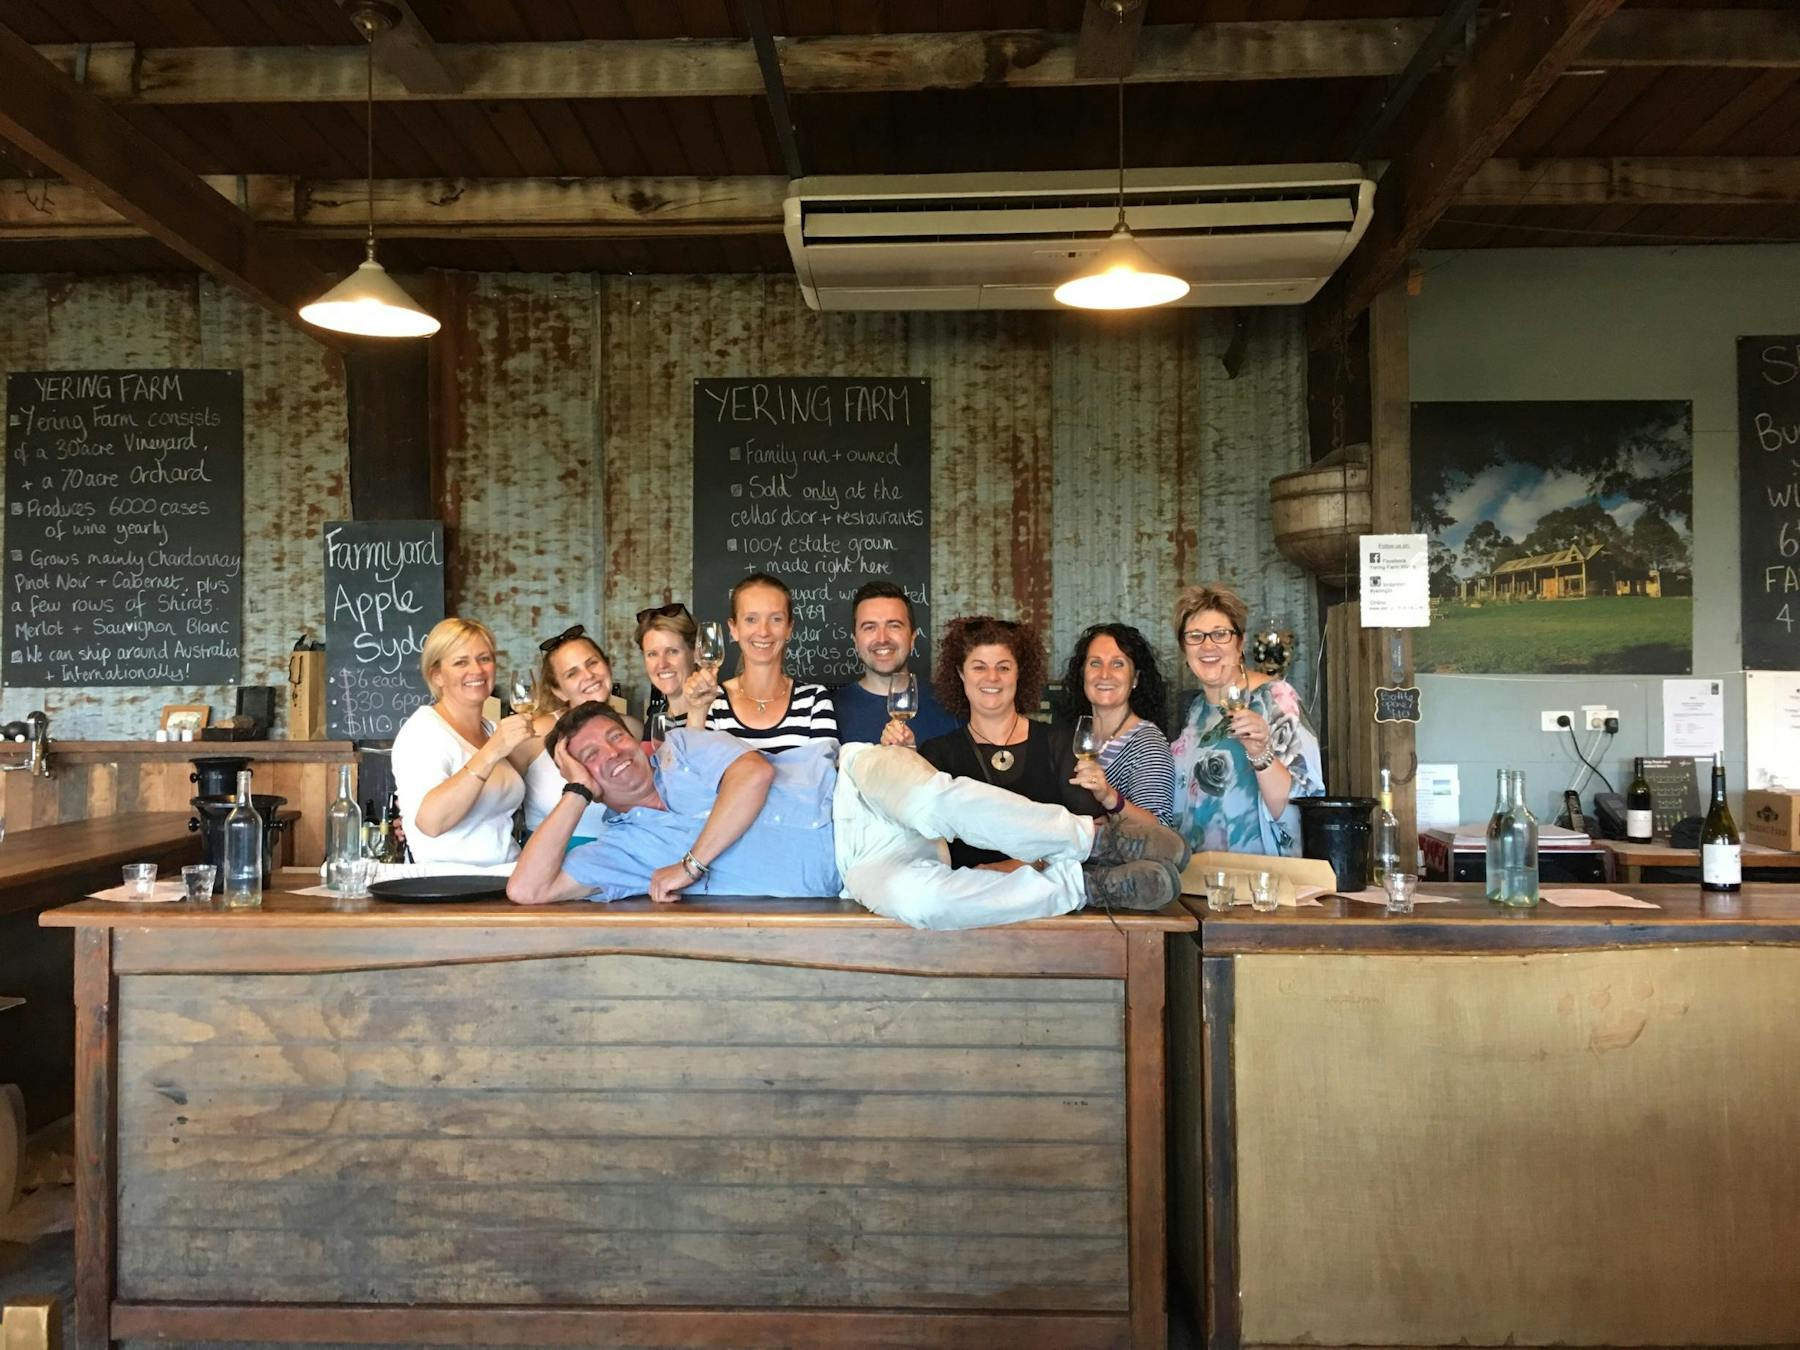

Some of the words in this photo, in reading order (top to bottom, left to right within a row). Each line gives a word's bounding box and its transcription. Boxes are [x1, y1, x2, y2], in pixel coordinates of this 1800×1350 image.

[34, 375, 112, 402] YERING
[120, 374, 183, 402] FARM
[704, 383, 833, 426] YERING
[845, 384, 910, 426] FARM
[20, 405, 88, 442] Yering
[92, 405, 138, 427] Farm
[148, 407, 221, 427] consists
[14, 442, 28, 466] of
[36, 447, 48, 459] a
[746, 438, 799, 479] Family
[803, 449, 830, 464] run
[846, 442, 902, 466] owned
[42, 476, 53, 489] a
[130, 459, 212, 484] Orchard
[749, 473, 792, 499] Sold
[803, 479, 840, 510] only
[845, 480, 867, 499] at
[873, 477, 903, 500] the
[27, 497, 97, 518] Produces
[109, 497, 158, 516] 6000
[160, 500, 211, 517] cases
[730, 503, 777, 528] cellar
[780, 505, 817, 526] door
[837, 507, 924, 527] restaurants
[45, 518, 66, 541] of
[73, 518, 107, 535] wine
[114, 518, 169, 546] yearly
[31, 549, 80, 569] Grows
[88, 551, 144, 577] mainly
[148, 546, 241, 577] Chardonnay
[325, 528, 443, 583] Farmyard
[743, 535, 783, 556] 100%
[789, 533, 841, 554] estate
[847, 535, 896, 564] grown
[766, 556, 811, 574] made
[815, 555, 852, 583] right
[859, 555, 893, 575] here
[15, 573, 49, 593] Pinot
[56, 572, 91, 591] Noir
[197, 576, 230, 598] plus
[791, 582, 833, 608] eyard
[11, 600, 22, 613] a
[30, 595, 61, 617] few
[72, 599, 114, 613] rows
[125, 590, 146, 617] of
[332, 580, 423, 633] Apple
[792, 604, 826, 622] 989
[15, 620, 64, 640] Merlot
[93, 618, 176, 640] Sauvignon
[186, 617, 229, 634] Blanc
[26, 645, 43, 663] We
[50, 649, 74, 661] can
[78, 643, 112, 667] ship
[117, 640, 169, 660] around
[174, 639, 240, 660] Australia
[353, 625, 430, 674] Syd
[61, 663, 190, 683] Internationally!
[338, 667, 369, 688] $6
[372, 672, 417, 690] each
[342, 690, 384, 714] $30
